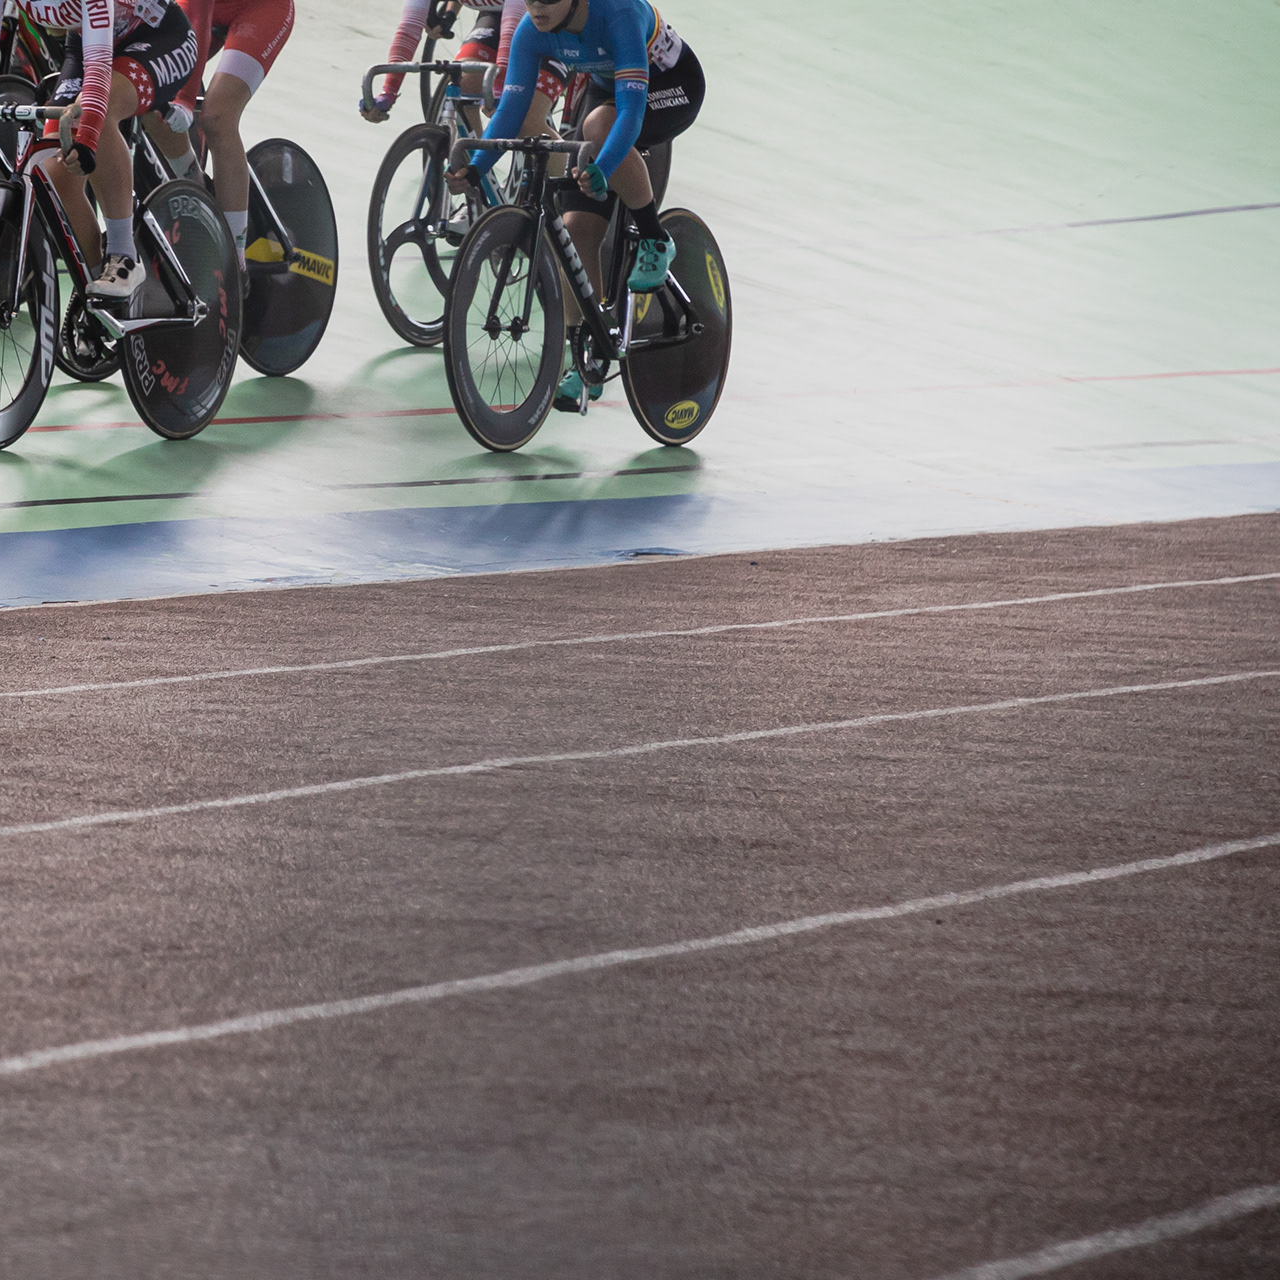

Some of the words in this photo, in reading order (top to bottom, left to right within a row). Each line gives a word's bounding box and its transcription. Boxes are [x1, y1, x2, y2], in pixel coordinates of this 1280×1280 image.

[648, 96, 690, 111] VALENCIANA
[298, 254, 333, 280] MAVIC
[671, 407, 695, 424] MAVIC
